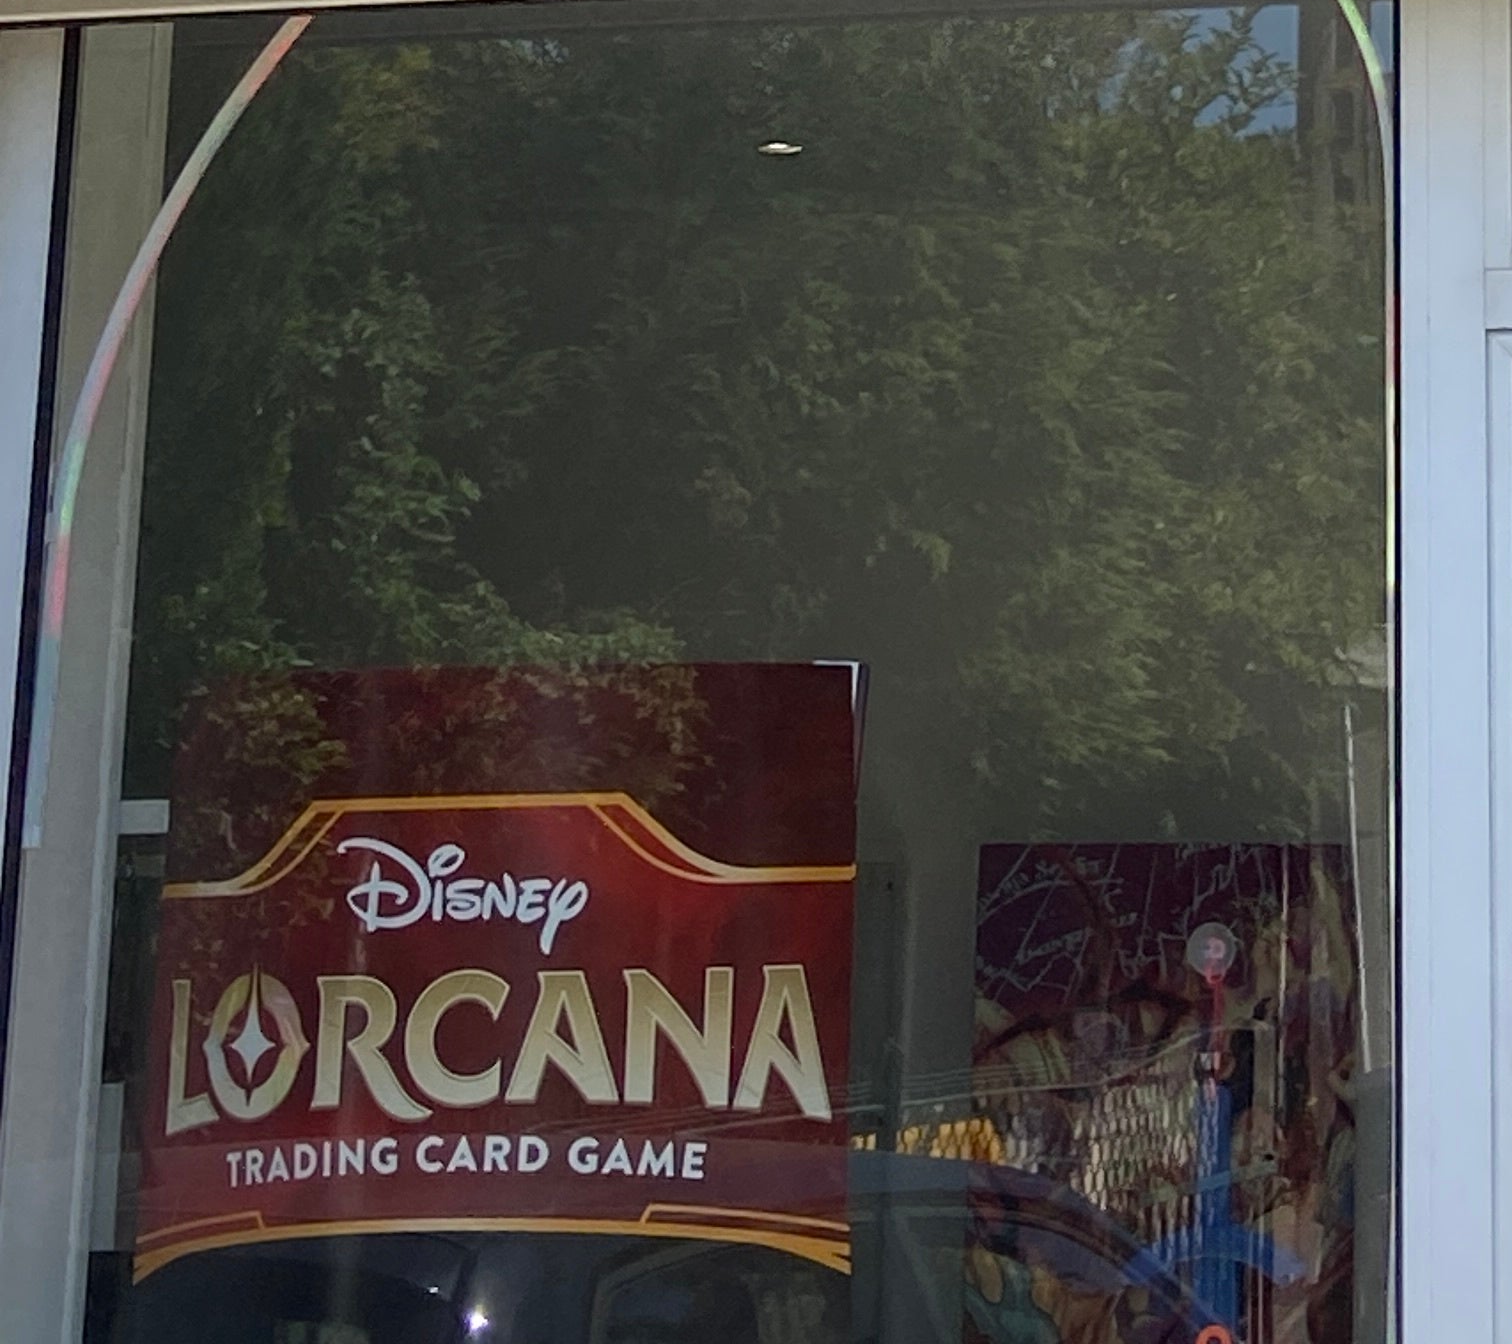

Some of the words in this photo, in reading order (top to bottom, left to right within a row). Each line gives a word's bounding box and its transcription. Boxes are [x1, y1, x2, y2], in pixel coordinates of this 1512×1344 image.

[164, 962, 833, 1136] LORCANA
[226, 1138, 398, 1188] TRADING
[415, 1135, 549, 1175] CARD
[567, 1136, 708, 1180] GAME
